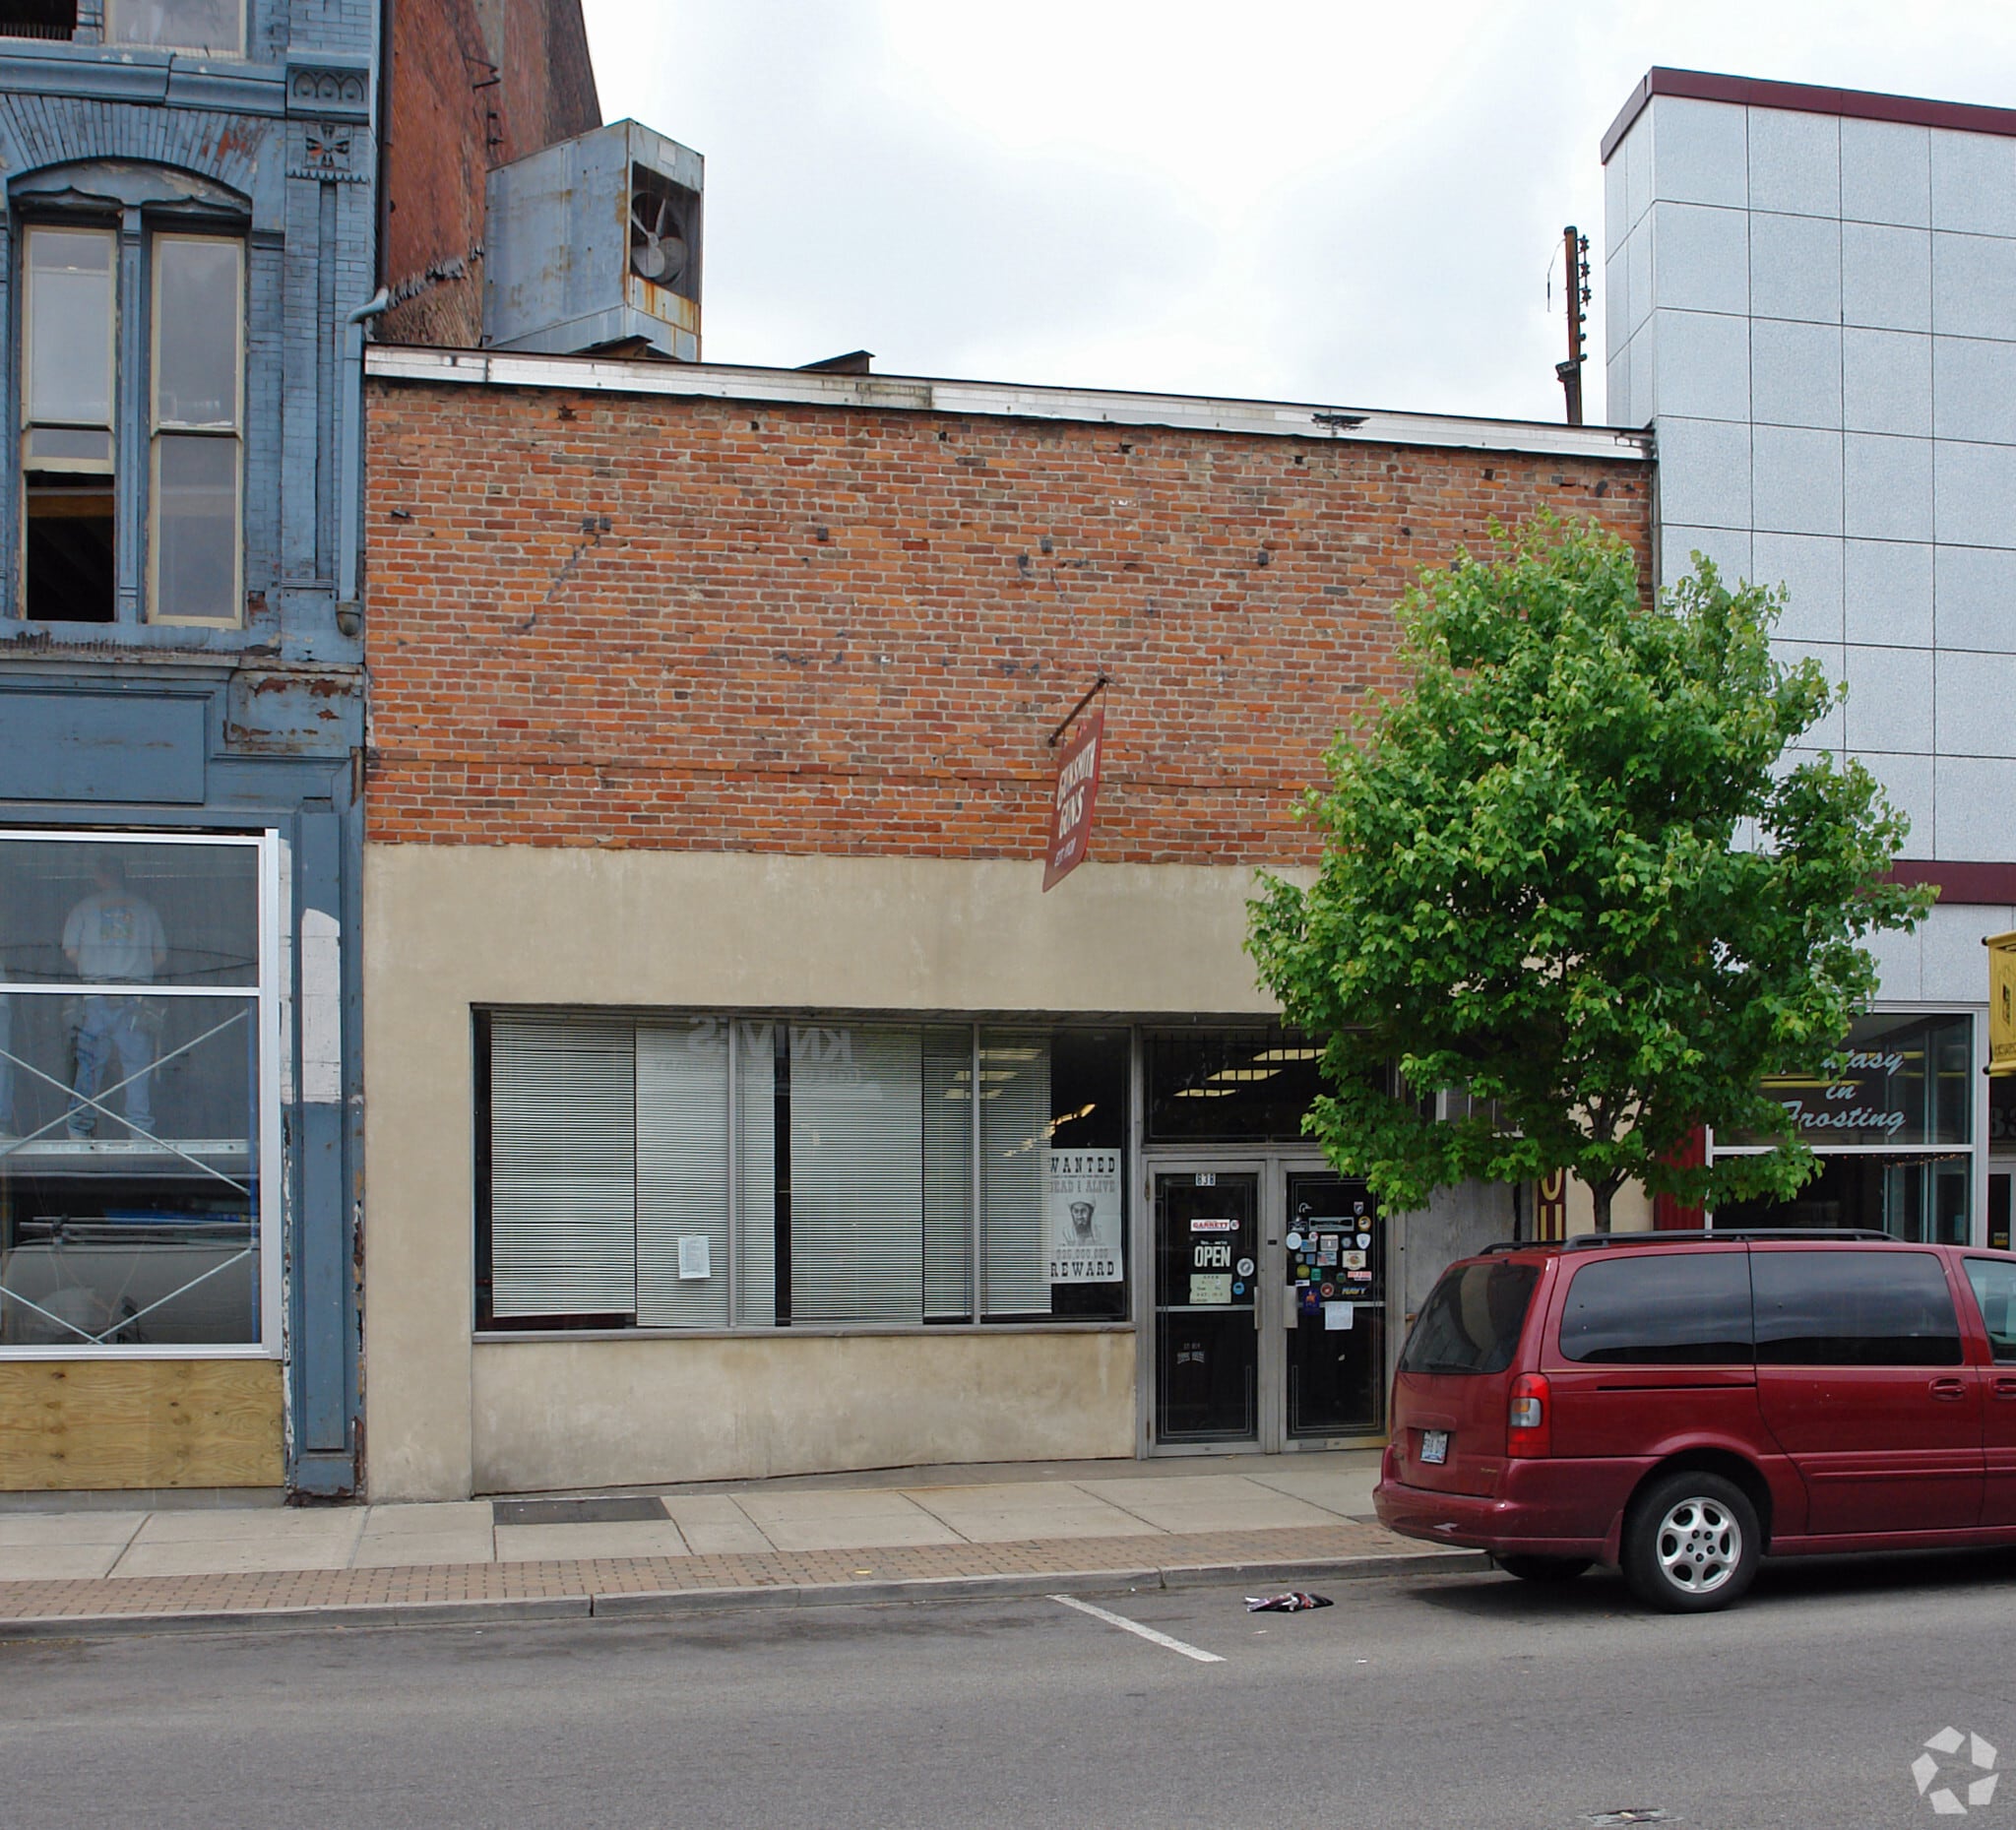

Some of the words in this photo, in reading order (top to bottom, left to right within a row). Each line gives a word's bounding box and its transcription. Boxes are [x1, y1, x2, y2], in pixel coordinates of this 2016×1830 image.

[1825, 1081, 1857, 1101] in
[1049, 1157, 1115, 1173] WANTED
[1050, 1180, 1074, 1193] EAD
[1086, 1180, 1115, 1193] ALIVE
[1194, 1245, 1230, 1268] OPEN
[1050, 1261, 1114, 1277] REWARD
